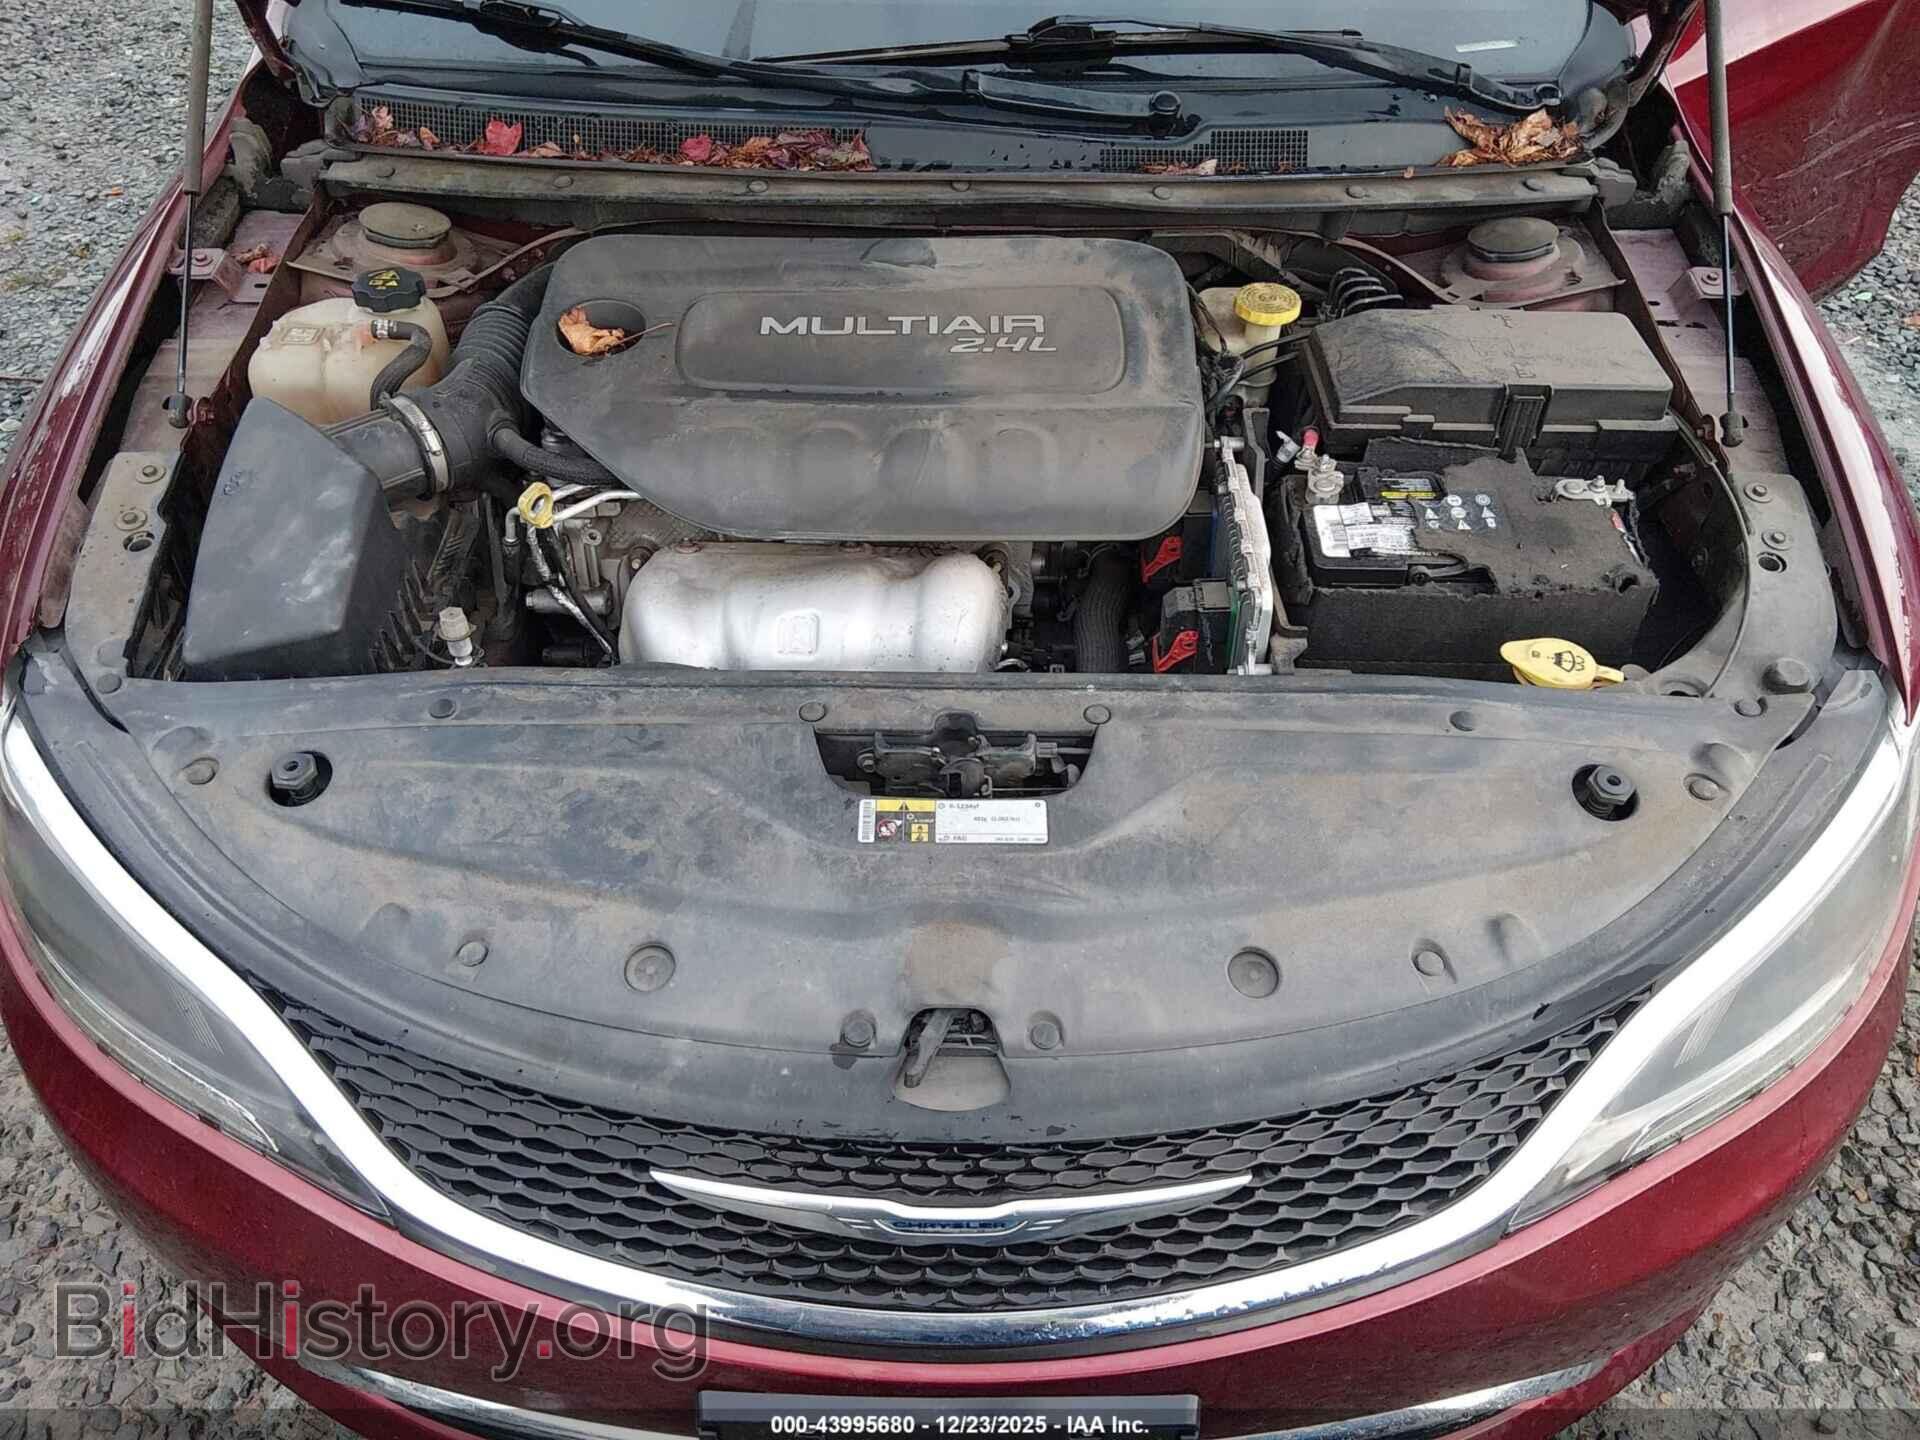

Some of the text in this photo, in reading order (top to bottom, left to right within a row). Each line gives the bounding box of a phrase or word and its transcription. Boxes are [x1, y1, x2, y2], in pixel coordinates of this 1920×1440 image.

[759, 316, 1045, 335] MULTIAIR
[950, 336, 1057, 353] 2.4L
[892, 1220, 1007, 1229] CHRYSLER
